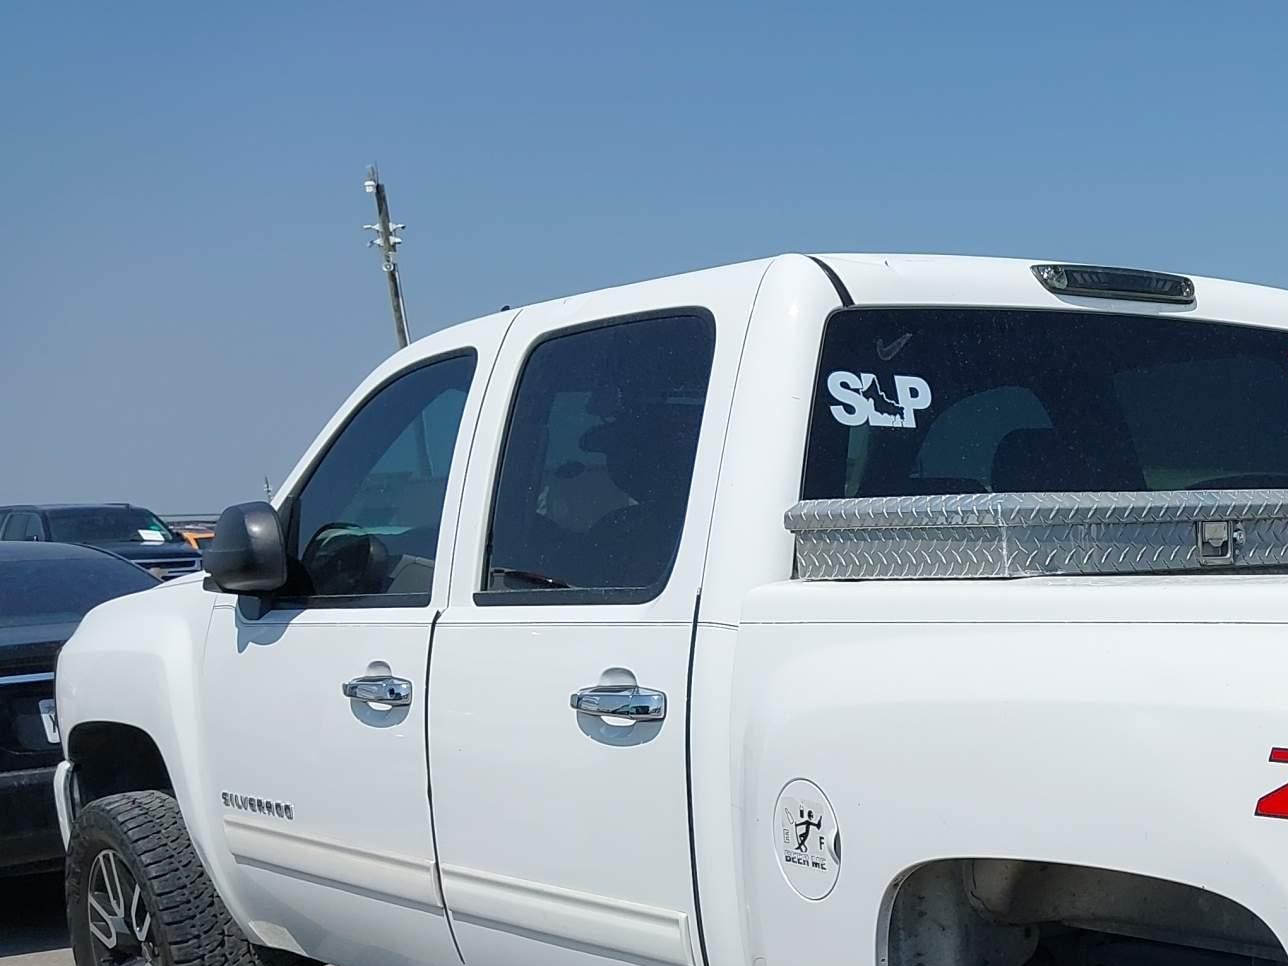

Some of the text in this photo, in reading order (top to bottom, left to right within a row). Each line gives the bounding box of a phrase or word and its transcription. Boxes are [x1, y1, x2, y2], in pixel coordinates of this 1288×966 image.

[827, 371, 932, 428] SLP
[221, 792, 295, 821] SILVERADO
[818, 836, 825, 851] F
